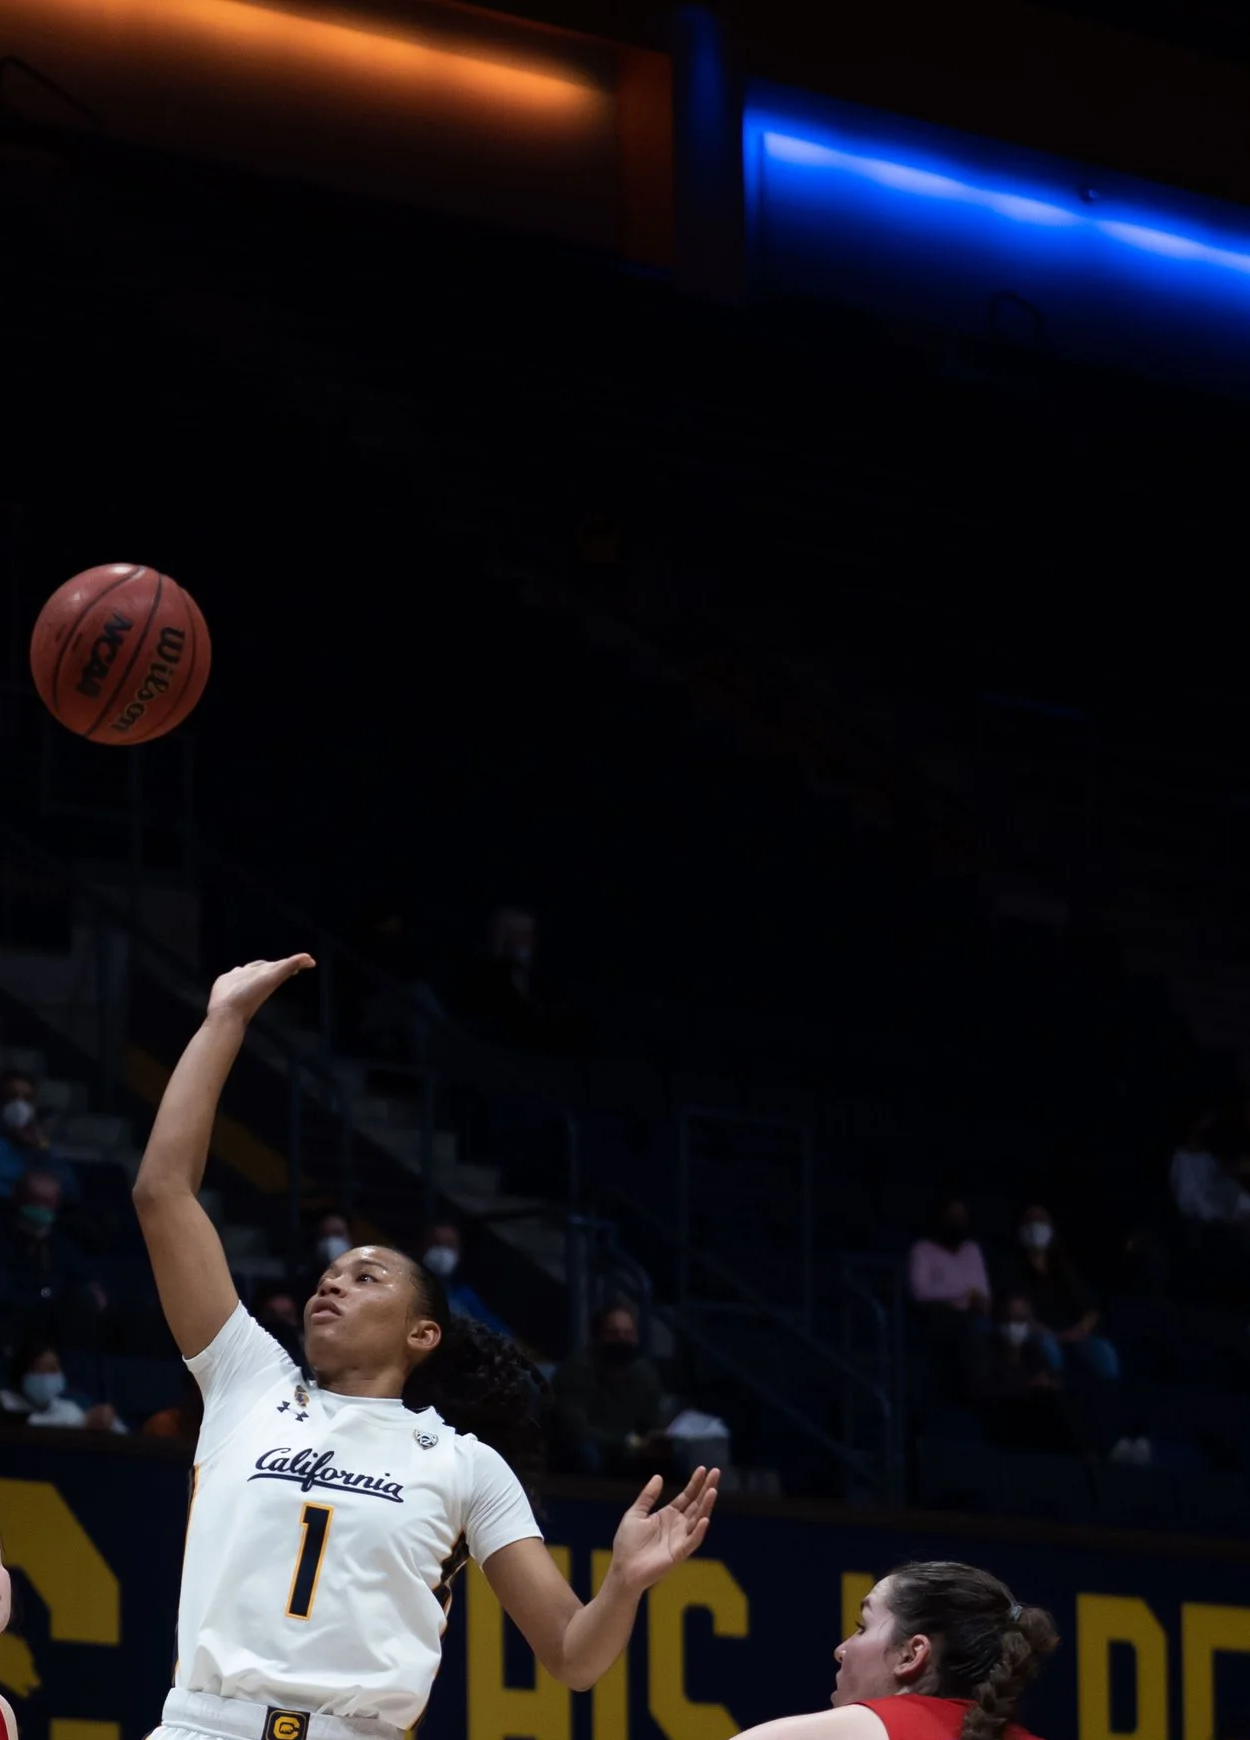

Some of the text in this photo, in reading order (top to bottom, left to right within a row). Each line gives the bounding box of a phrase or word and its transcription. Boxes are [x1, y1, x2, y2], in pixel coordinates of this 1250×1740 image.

[75, 611, 133, 698] NCAA
[110, 626, 186, 733] Wilson
[247, 1447, 405, 1503] California
[285, 1501, 335, 1621] 1
